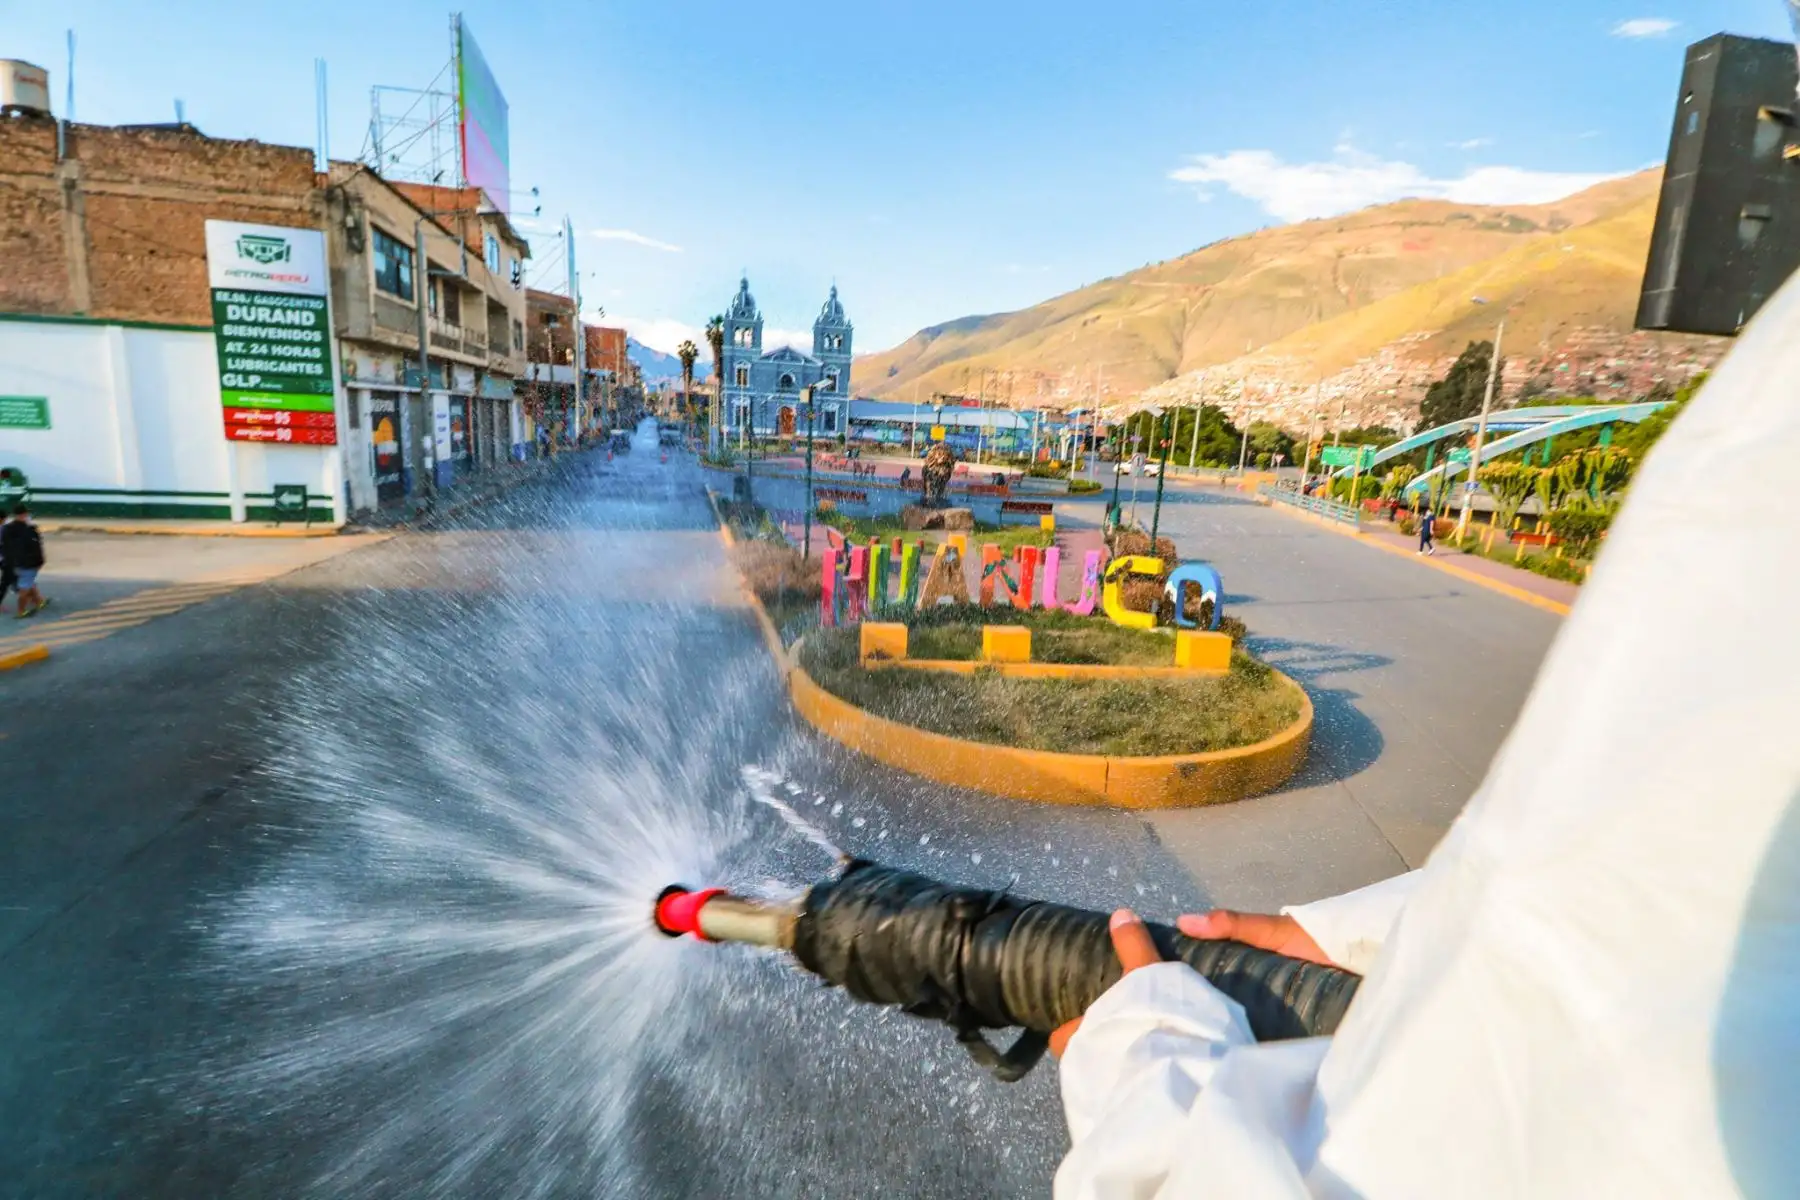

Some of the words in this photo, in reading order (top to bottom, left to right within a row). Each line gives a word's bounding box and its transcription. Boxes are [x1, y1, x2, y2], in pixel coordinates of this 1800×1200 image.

[226, 304, 316, 326] DURAND
[222, 323, 322, 342] BIENVENIDOS
[225, 341, 247, 353] AT.
[250, 343, 269, 355] 24
[271, 344, 322, 359] HORAS
[226, 358, 324, 375] LUBRICANTES
[222, 372, 261, 388] GLP
[274, 411, 291, 425] 95
